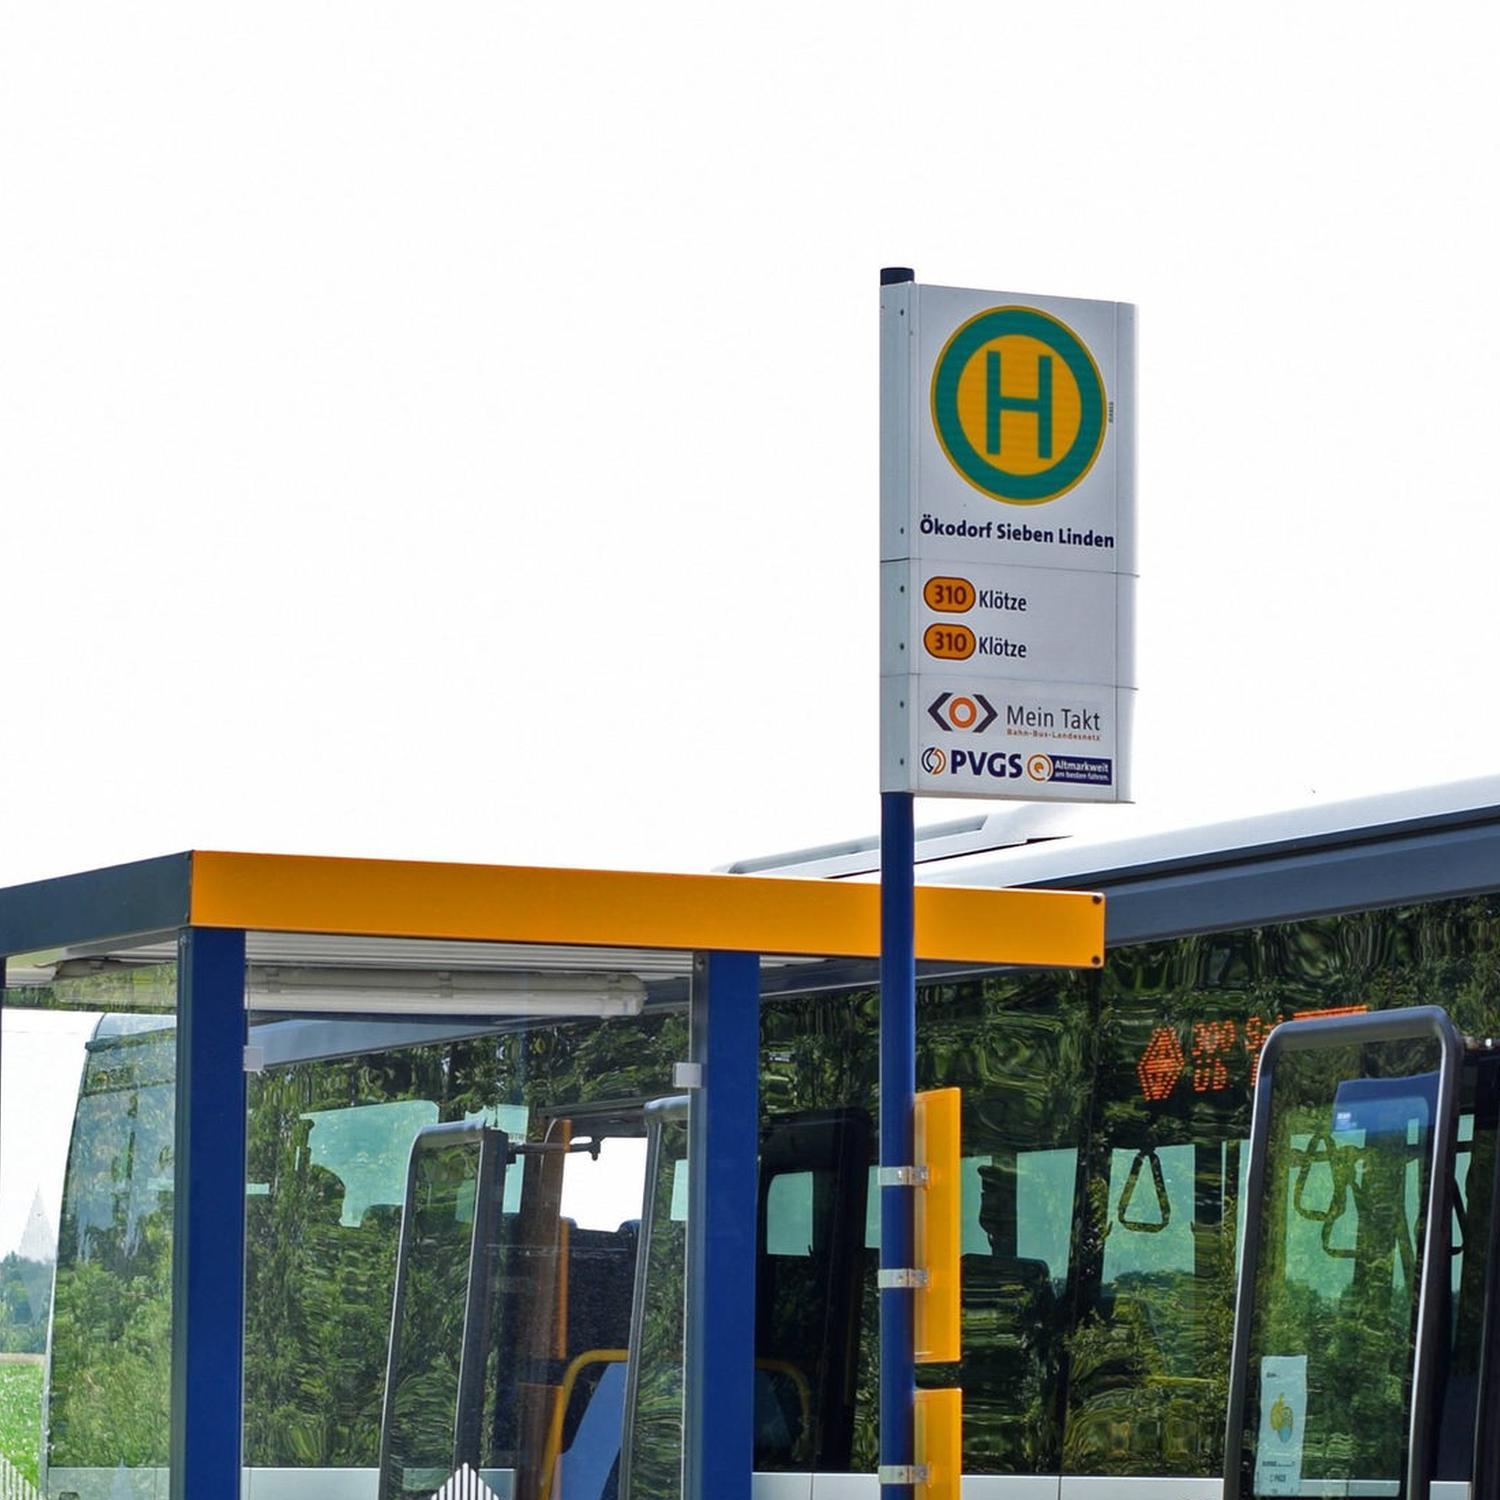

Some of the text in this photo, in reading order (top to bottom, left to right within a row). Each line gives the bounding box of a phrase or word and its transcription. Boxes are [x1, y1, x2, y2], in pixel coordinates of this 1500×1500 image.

[985, 350, 1054, 460] H
[919, 513, 1115, 549] Ökodorf Sieben Linden
[934, 584, 1028, 612] 310 Klötze
[934, 631, 1028, 659] 310 Klötze
[1006, 705, 1101, 732] Mein Takt
[950, 749, 1024, 779] PVGS
